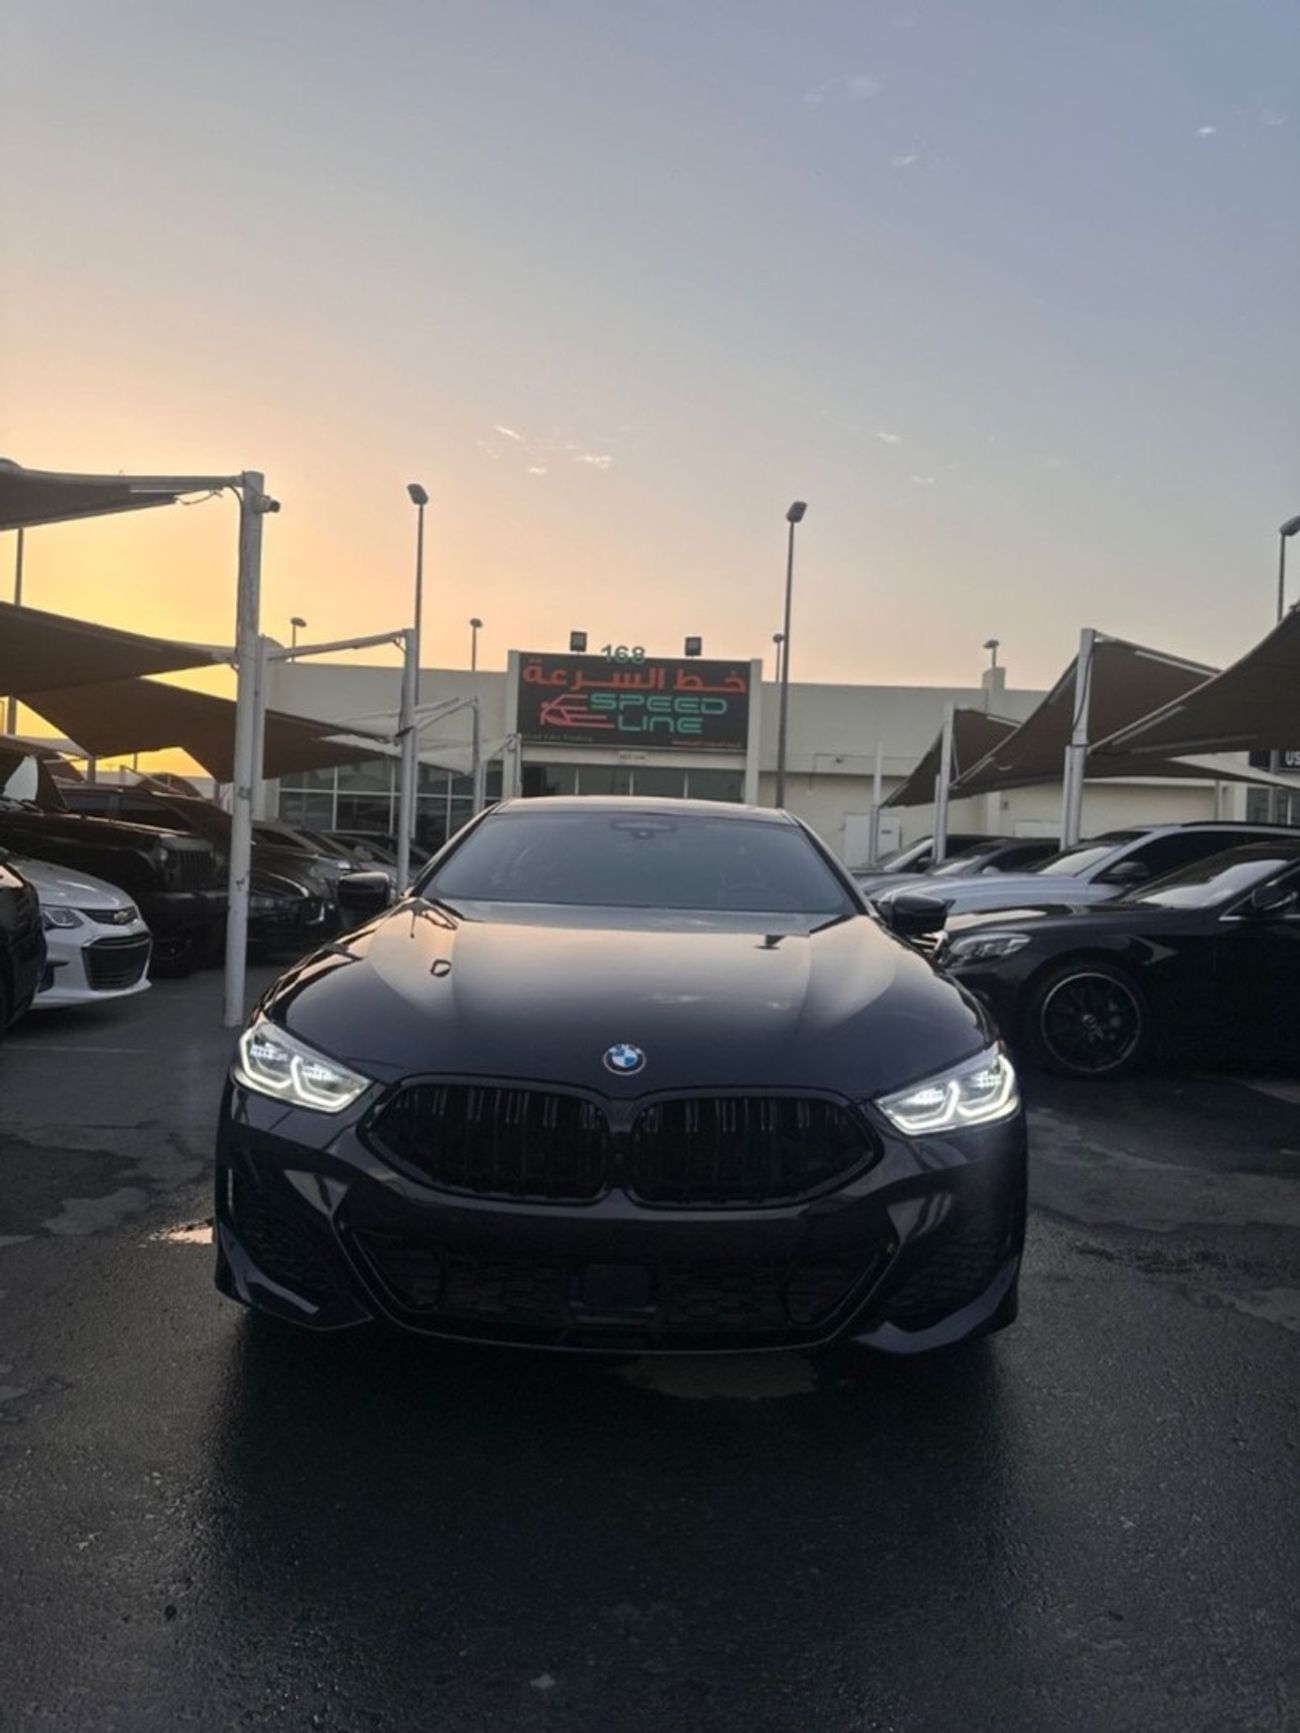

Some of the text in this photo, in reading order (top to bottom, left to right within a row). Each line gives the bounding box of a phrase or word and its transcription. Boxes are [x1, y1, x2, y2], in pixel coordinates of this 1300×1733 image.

[601, 645, 646, 664] 168
[523, 658, 746, 694] خط السرعة
[590, 693, 727, 715] SPEED
[618, 715, 703, 734] LINE
